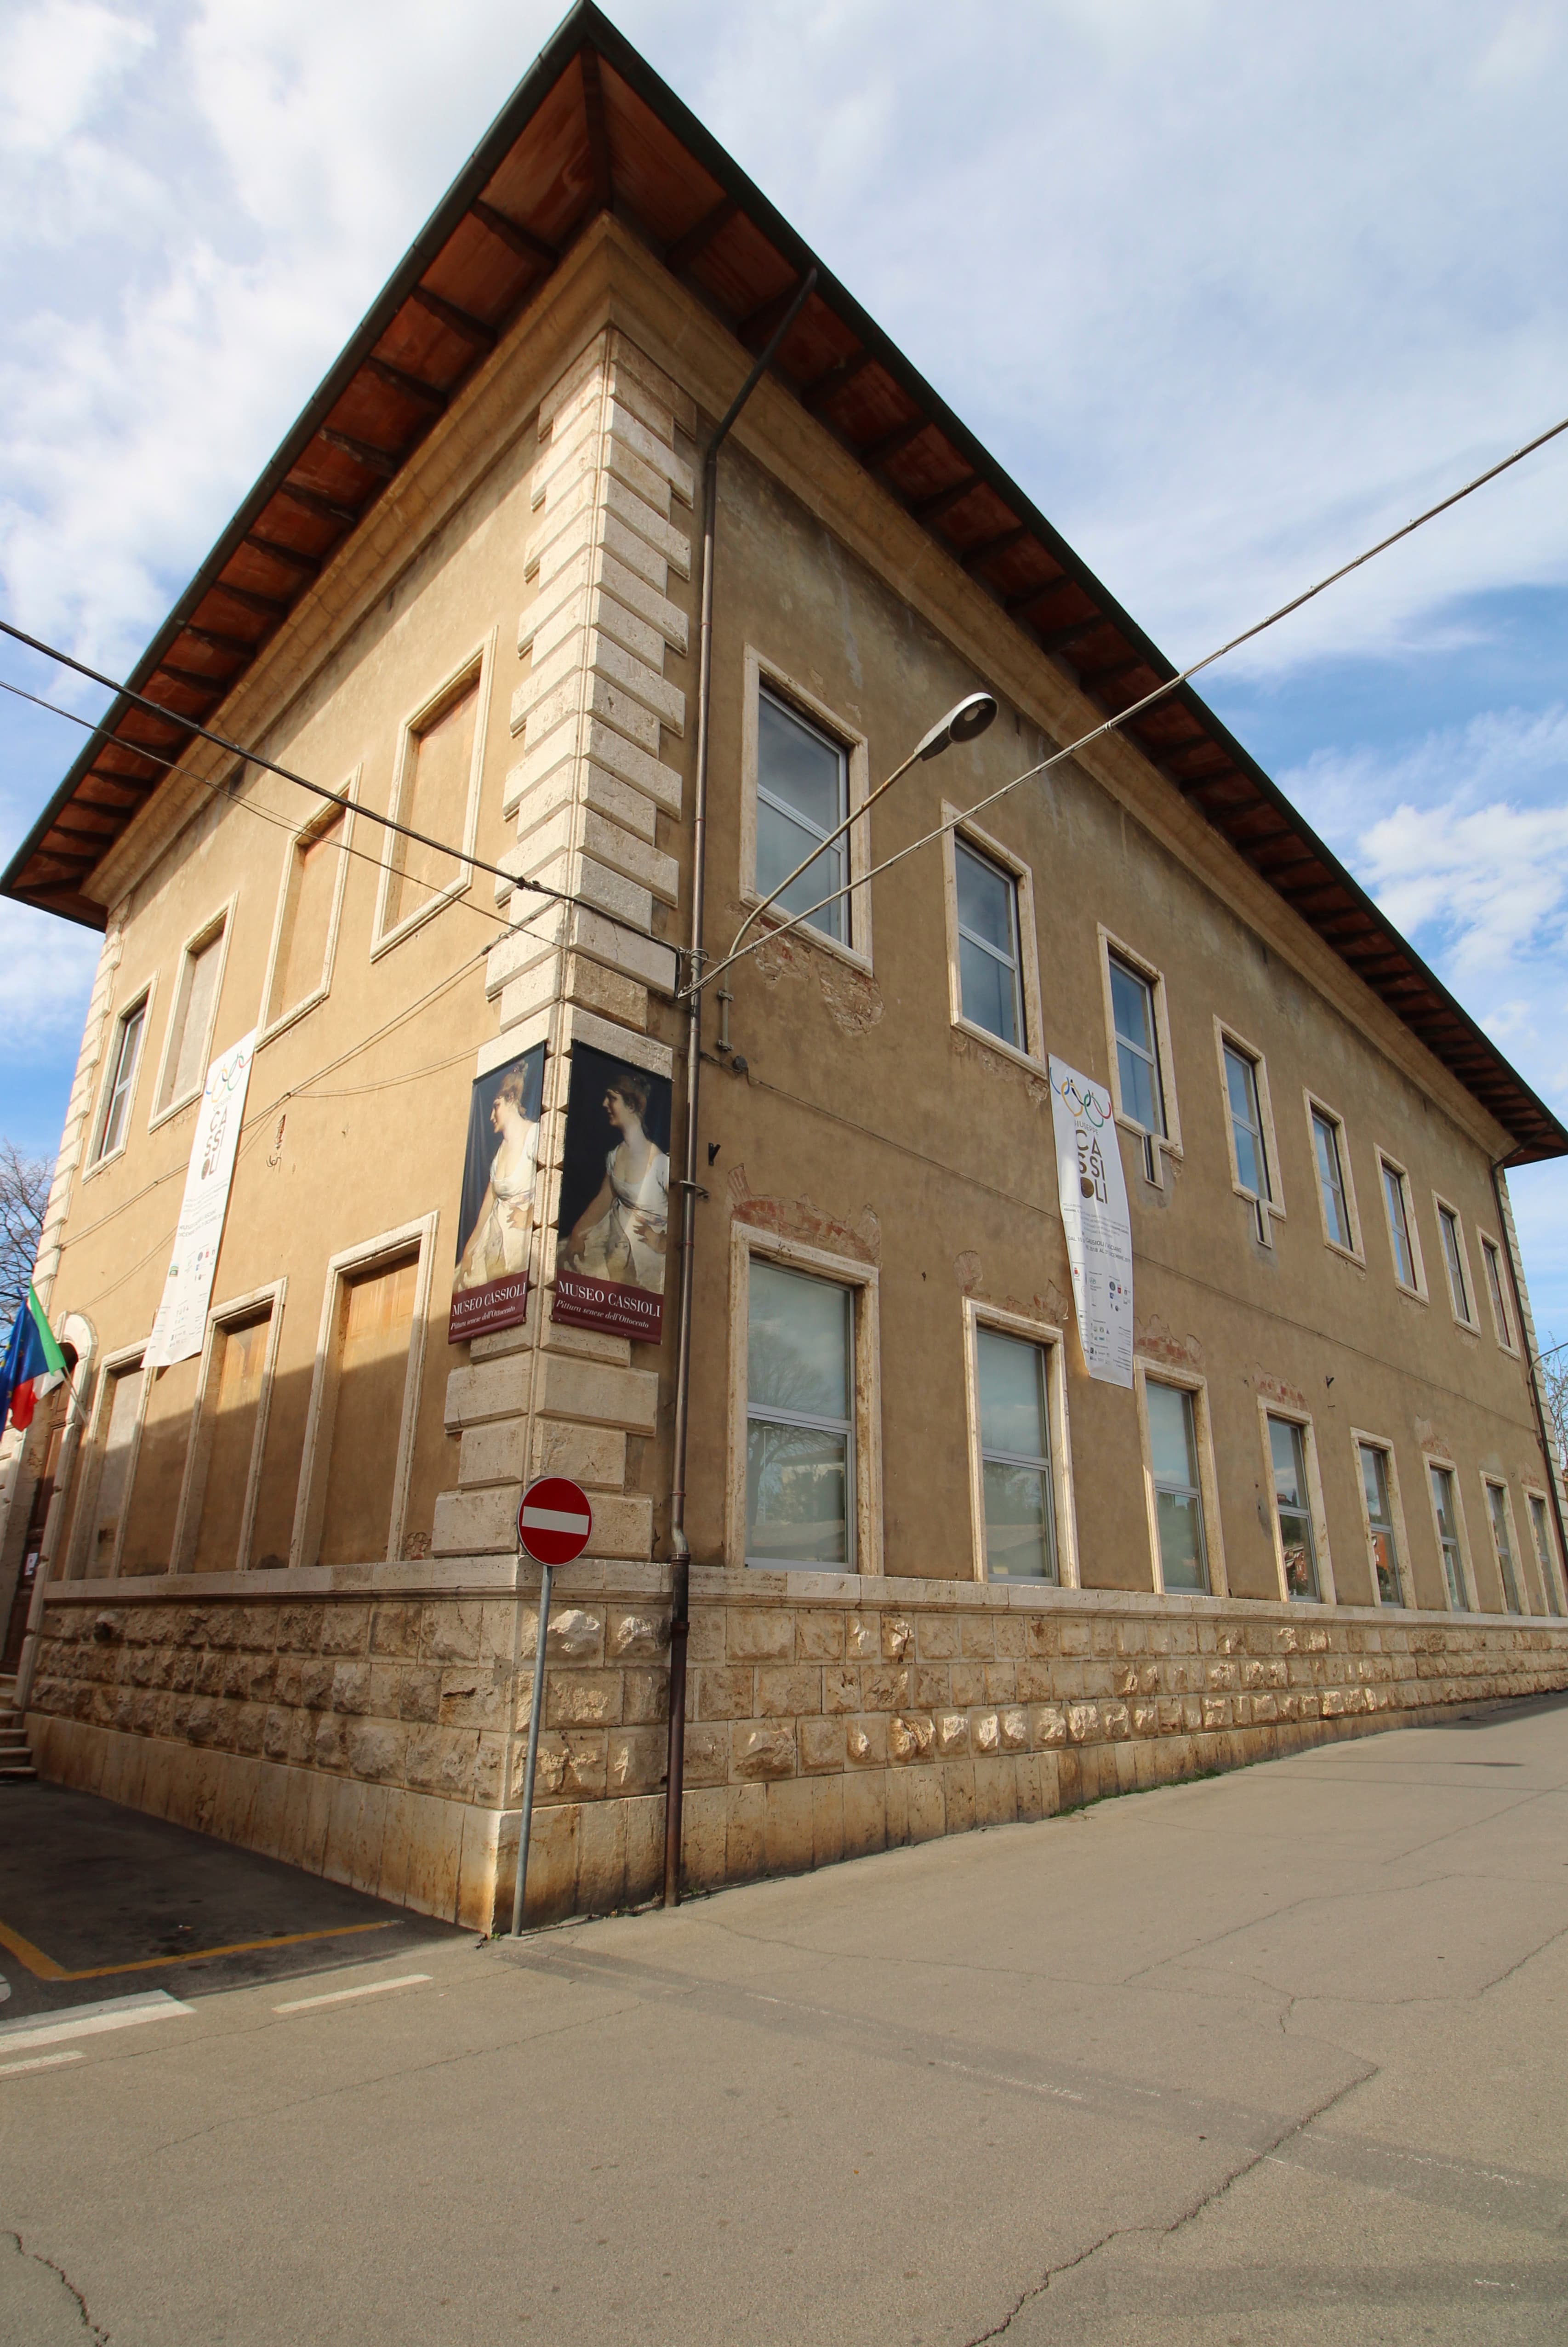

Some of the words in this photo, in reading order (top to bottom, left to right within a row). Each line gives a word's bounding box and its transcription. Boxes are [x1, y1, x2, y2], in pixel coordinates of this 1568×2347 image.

[452, 1296, 482, 1317] MUSEO
[484, 1282, 526, 1306] CASSIOLI
[556, 1299, 582, 1312] Pittura
[582, 1308, 604, 1318] senese
[605, 1312, 649, 1328] dell'Ottocento
[559, 1280, 604, 1302] MUSEO
[608, 1293, 661, 1317] CASSIOLI
[450, 1321, 466, 1330] Pittura
[467, 1316, 481, 1325] senese
[482, 1306, 515, 1321] dell'Ottocento
